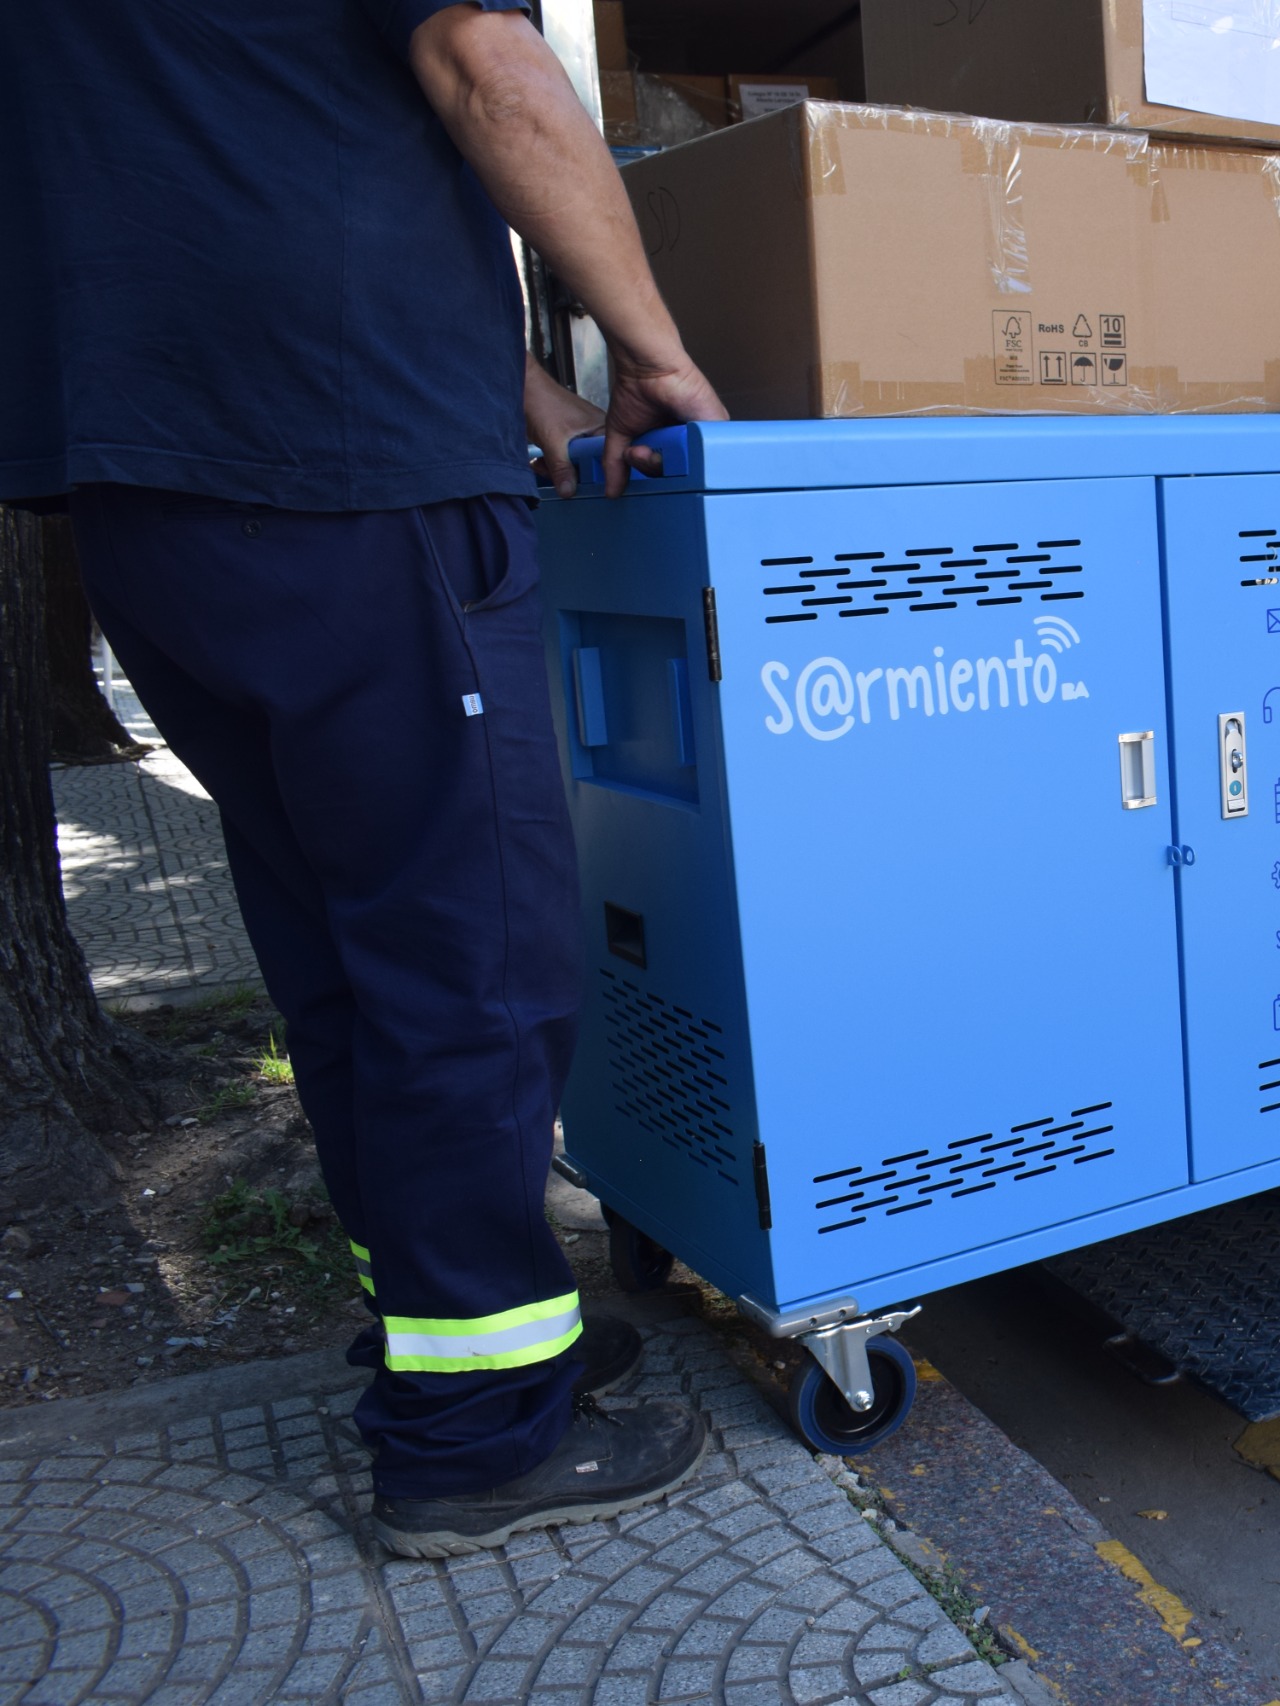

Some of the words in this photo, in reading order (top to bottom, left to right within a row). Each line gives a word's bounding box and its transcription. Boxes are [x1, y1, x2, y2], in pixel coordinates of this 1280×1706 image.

[1039, 323, 1065, 334] RoHS
[1103, 317, 1121, 333] 10
[1005, 339, 1022, 348] FSC
[761, 638, 1057, 741] S@rmiento
